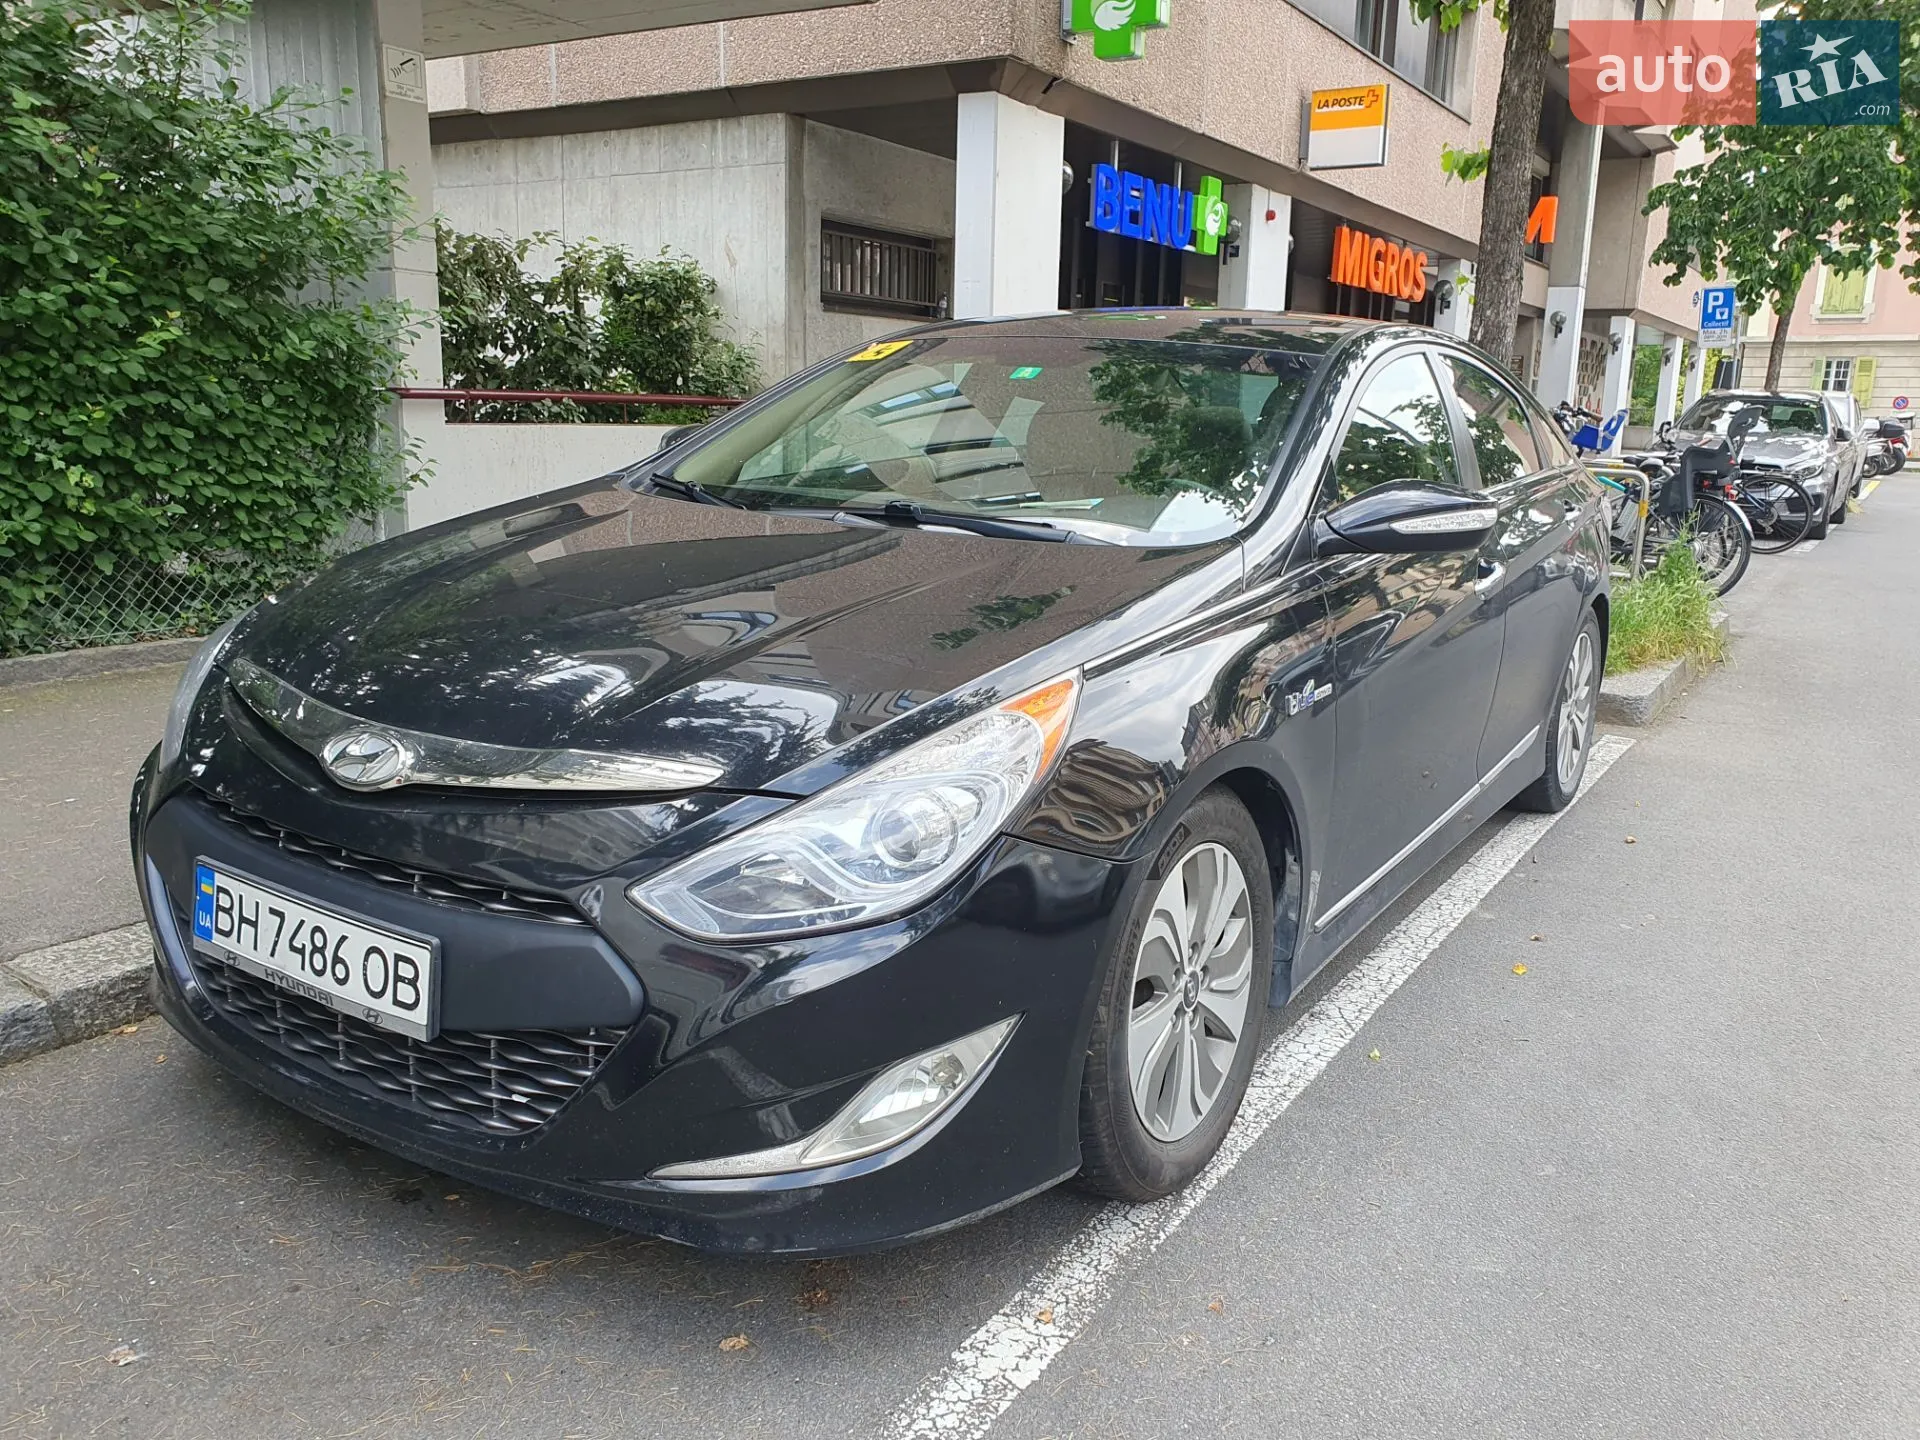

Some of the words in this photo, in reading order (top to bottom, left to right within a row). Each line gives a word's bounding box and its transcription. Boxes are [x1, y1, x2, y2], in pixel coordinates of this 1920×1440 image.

[1317, 99, 1330, 110] LA
[1331, 95, 1366, 109] POSTE
[1094, 163, 1193, 249] BENU
[1333, 226, 1428, 302] MIGROS
[1708, 291, 1724, 313] P
[199, 910, 212, 930] UA
[215, 884, 260, 951] BH
[268, 906, 350, 987] 7486
[363, 945, 421, 1011] OB
[264, 968, 334, 1006] HYUNDAI
